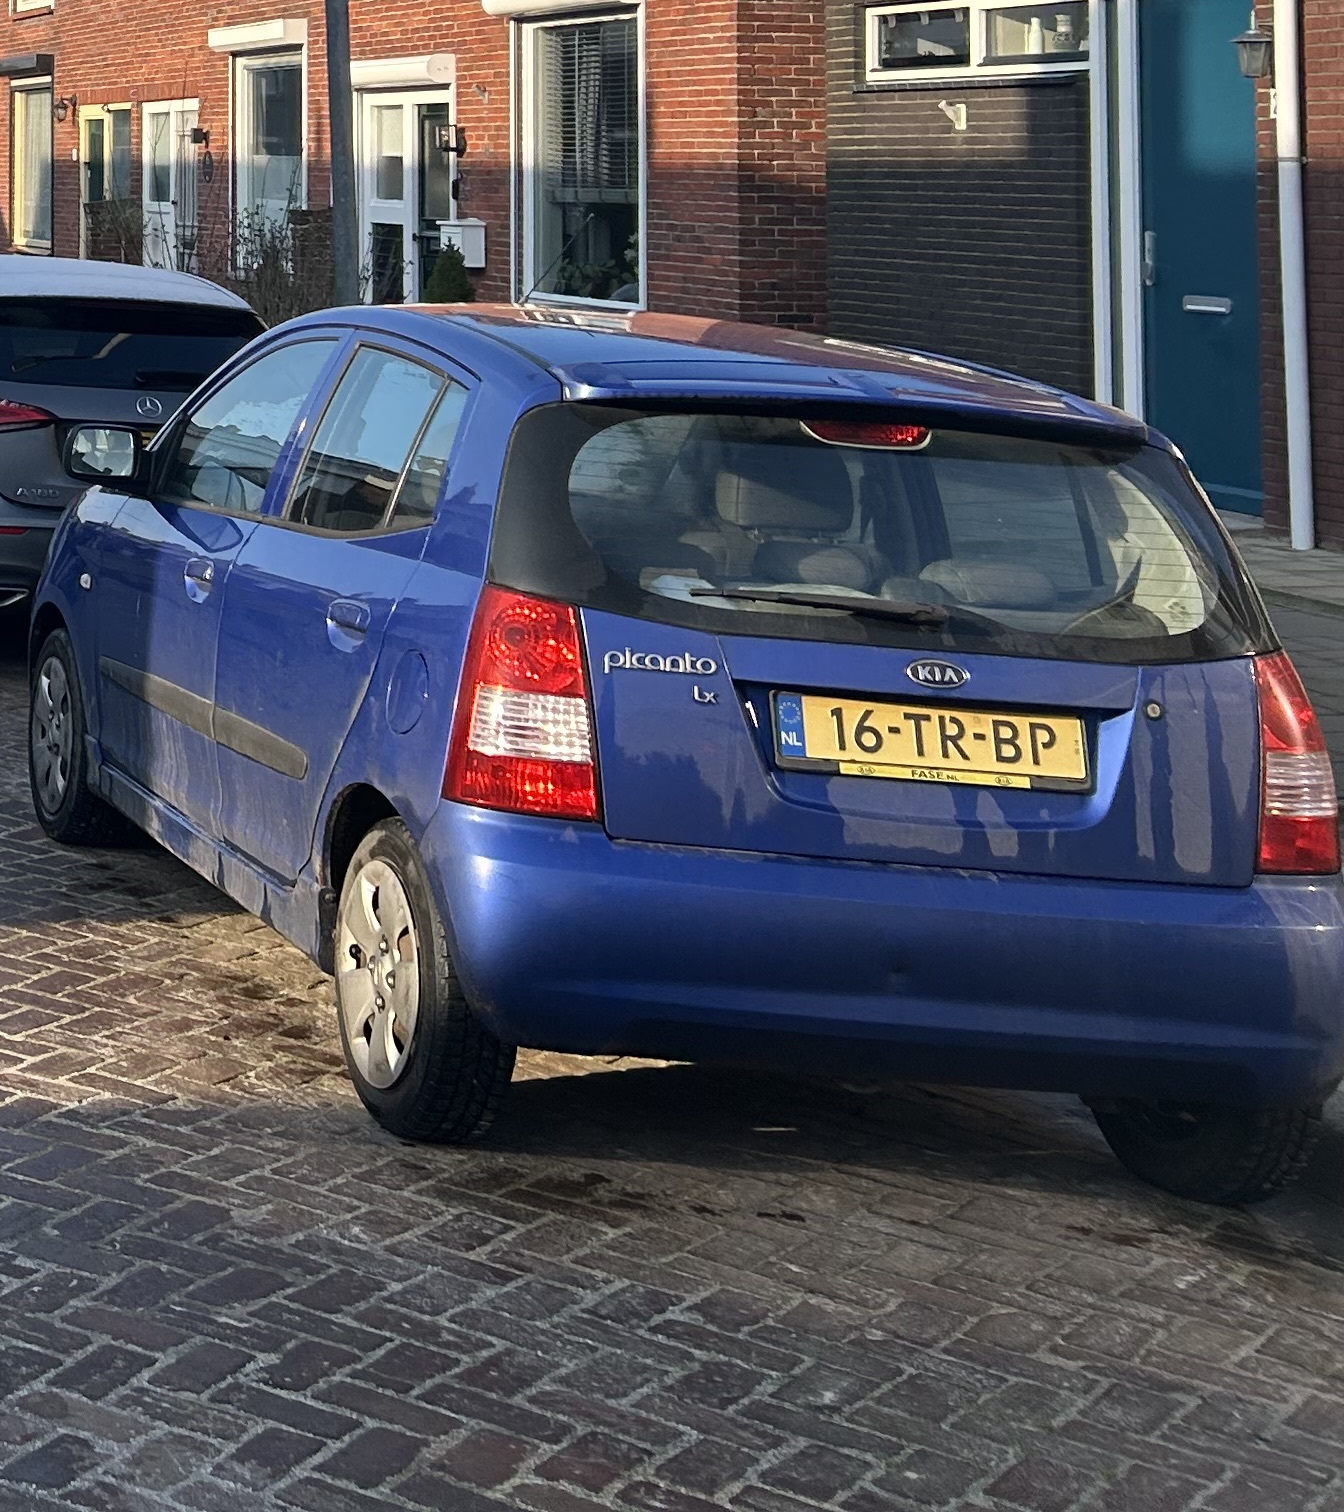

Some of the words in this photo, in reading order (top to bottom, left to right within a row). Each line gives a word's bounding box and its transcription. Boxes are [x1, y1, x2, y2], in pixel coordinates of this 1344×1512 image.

[603, 646, 717, 674] picanto
[916, 665, 959, 683] KIA
[780, 731, 803, 747] NL
[830, 706, 1057, 766] 16-TR-BP
[911, 769, 960, 782] FASE.NL
